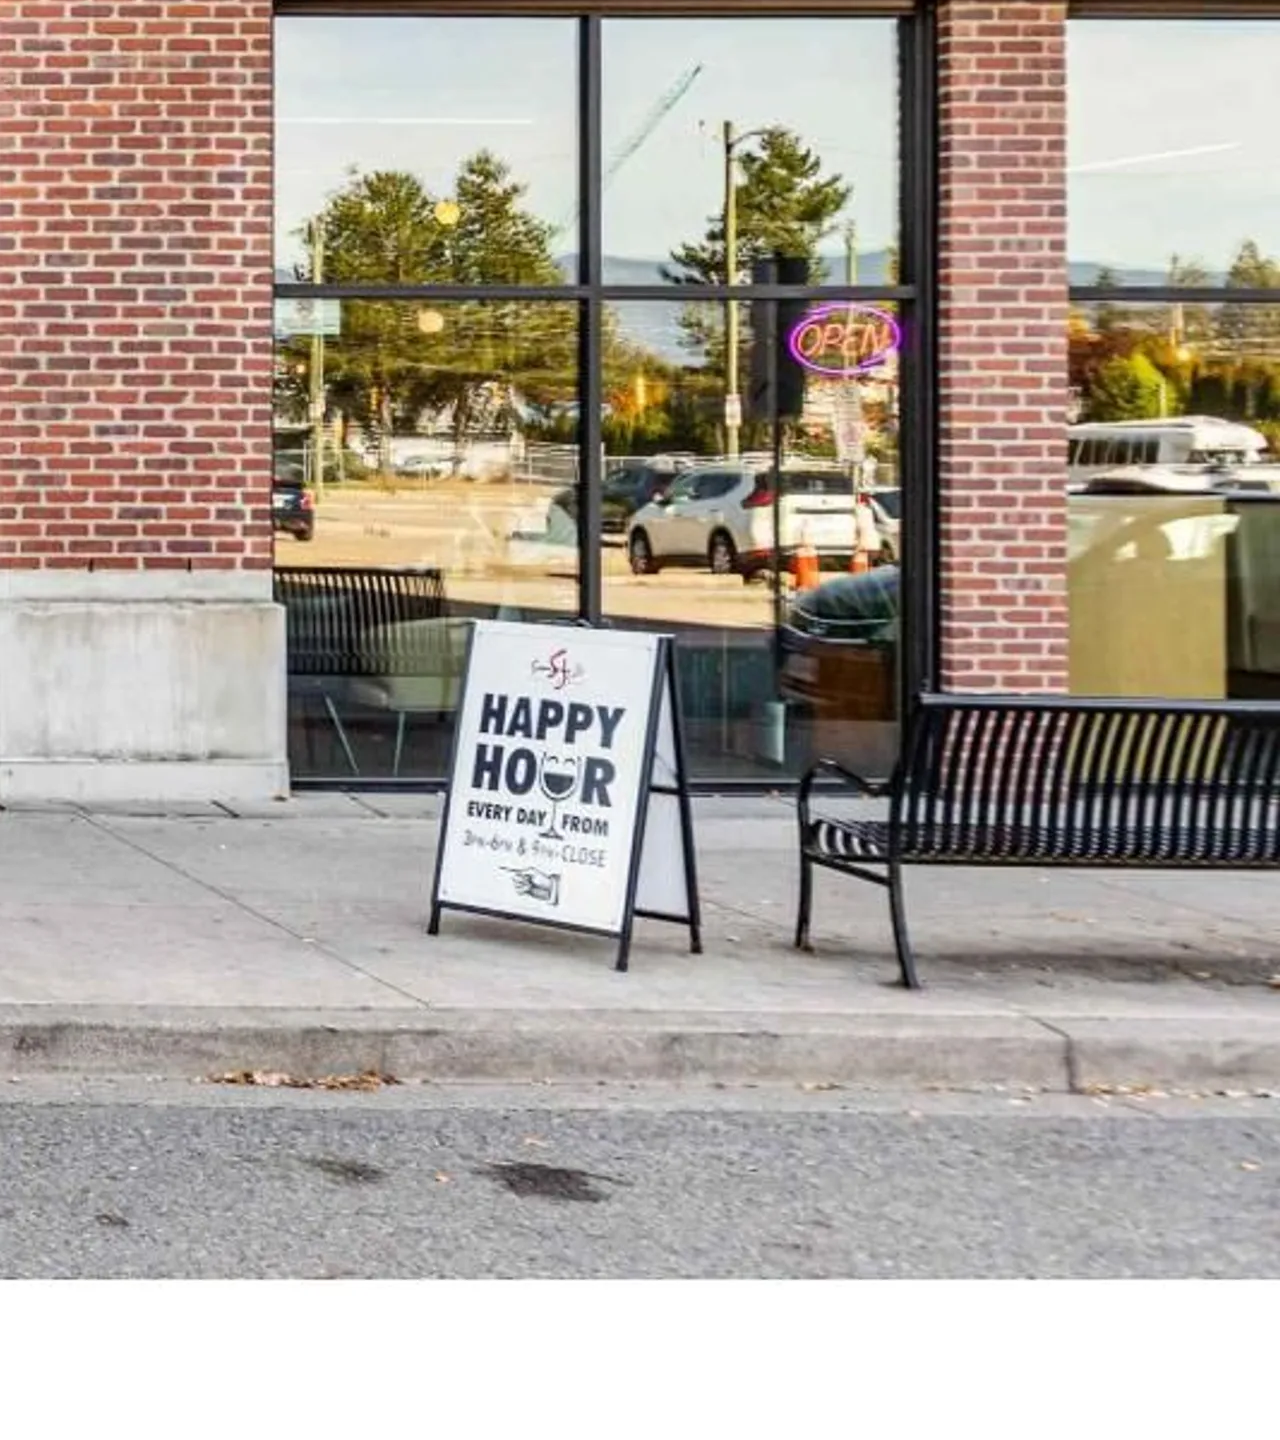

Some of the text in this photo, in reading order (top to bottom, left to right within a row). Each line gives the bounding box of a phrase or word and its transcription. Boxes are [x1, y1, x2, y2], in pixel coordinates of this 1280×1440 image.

[797, 323, 890, 358] OPEN
[479, 692, 627, 749] HAPPY
[466, 800, 609, 837] EVERY DAY FROM
